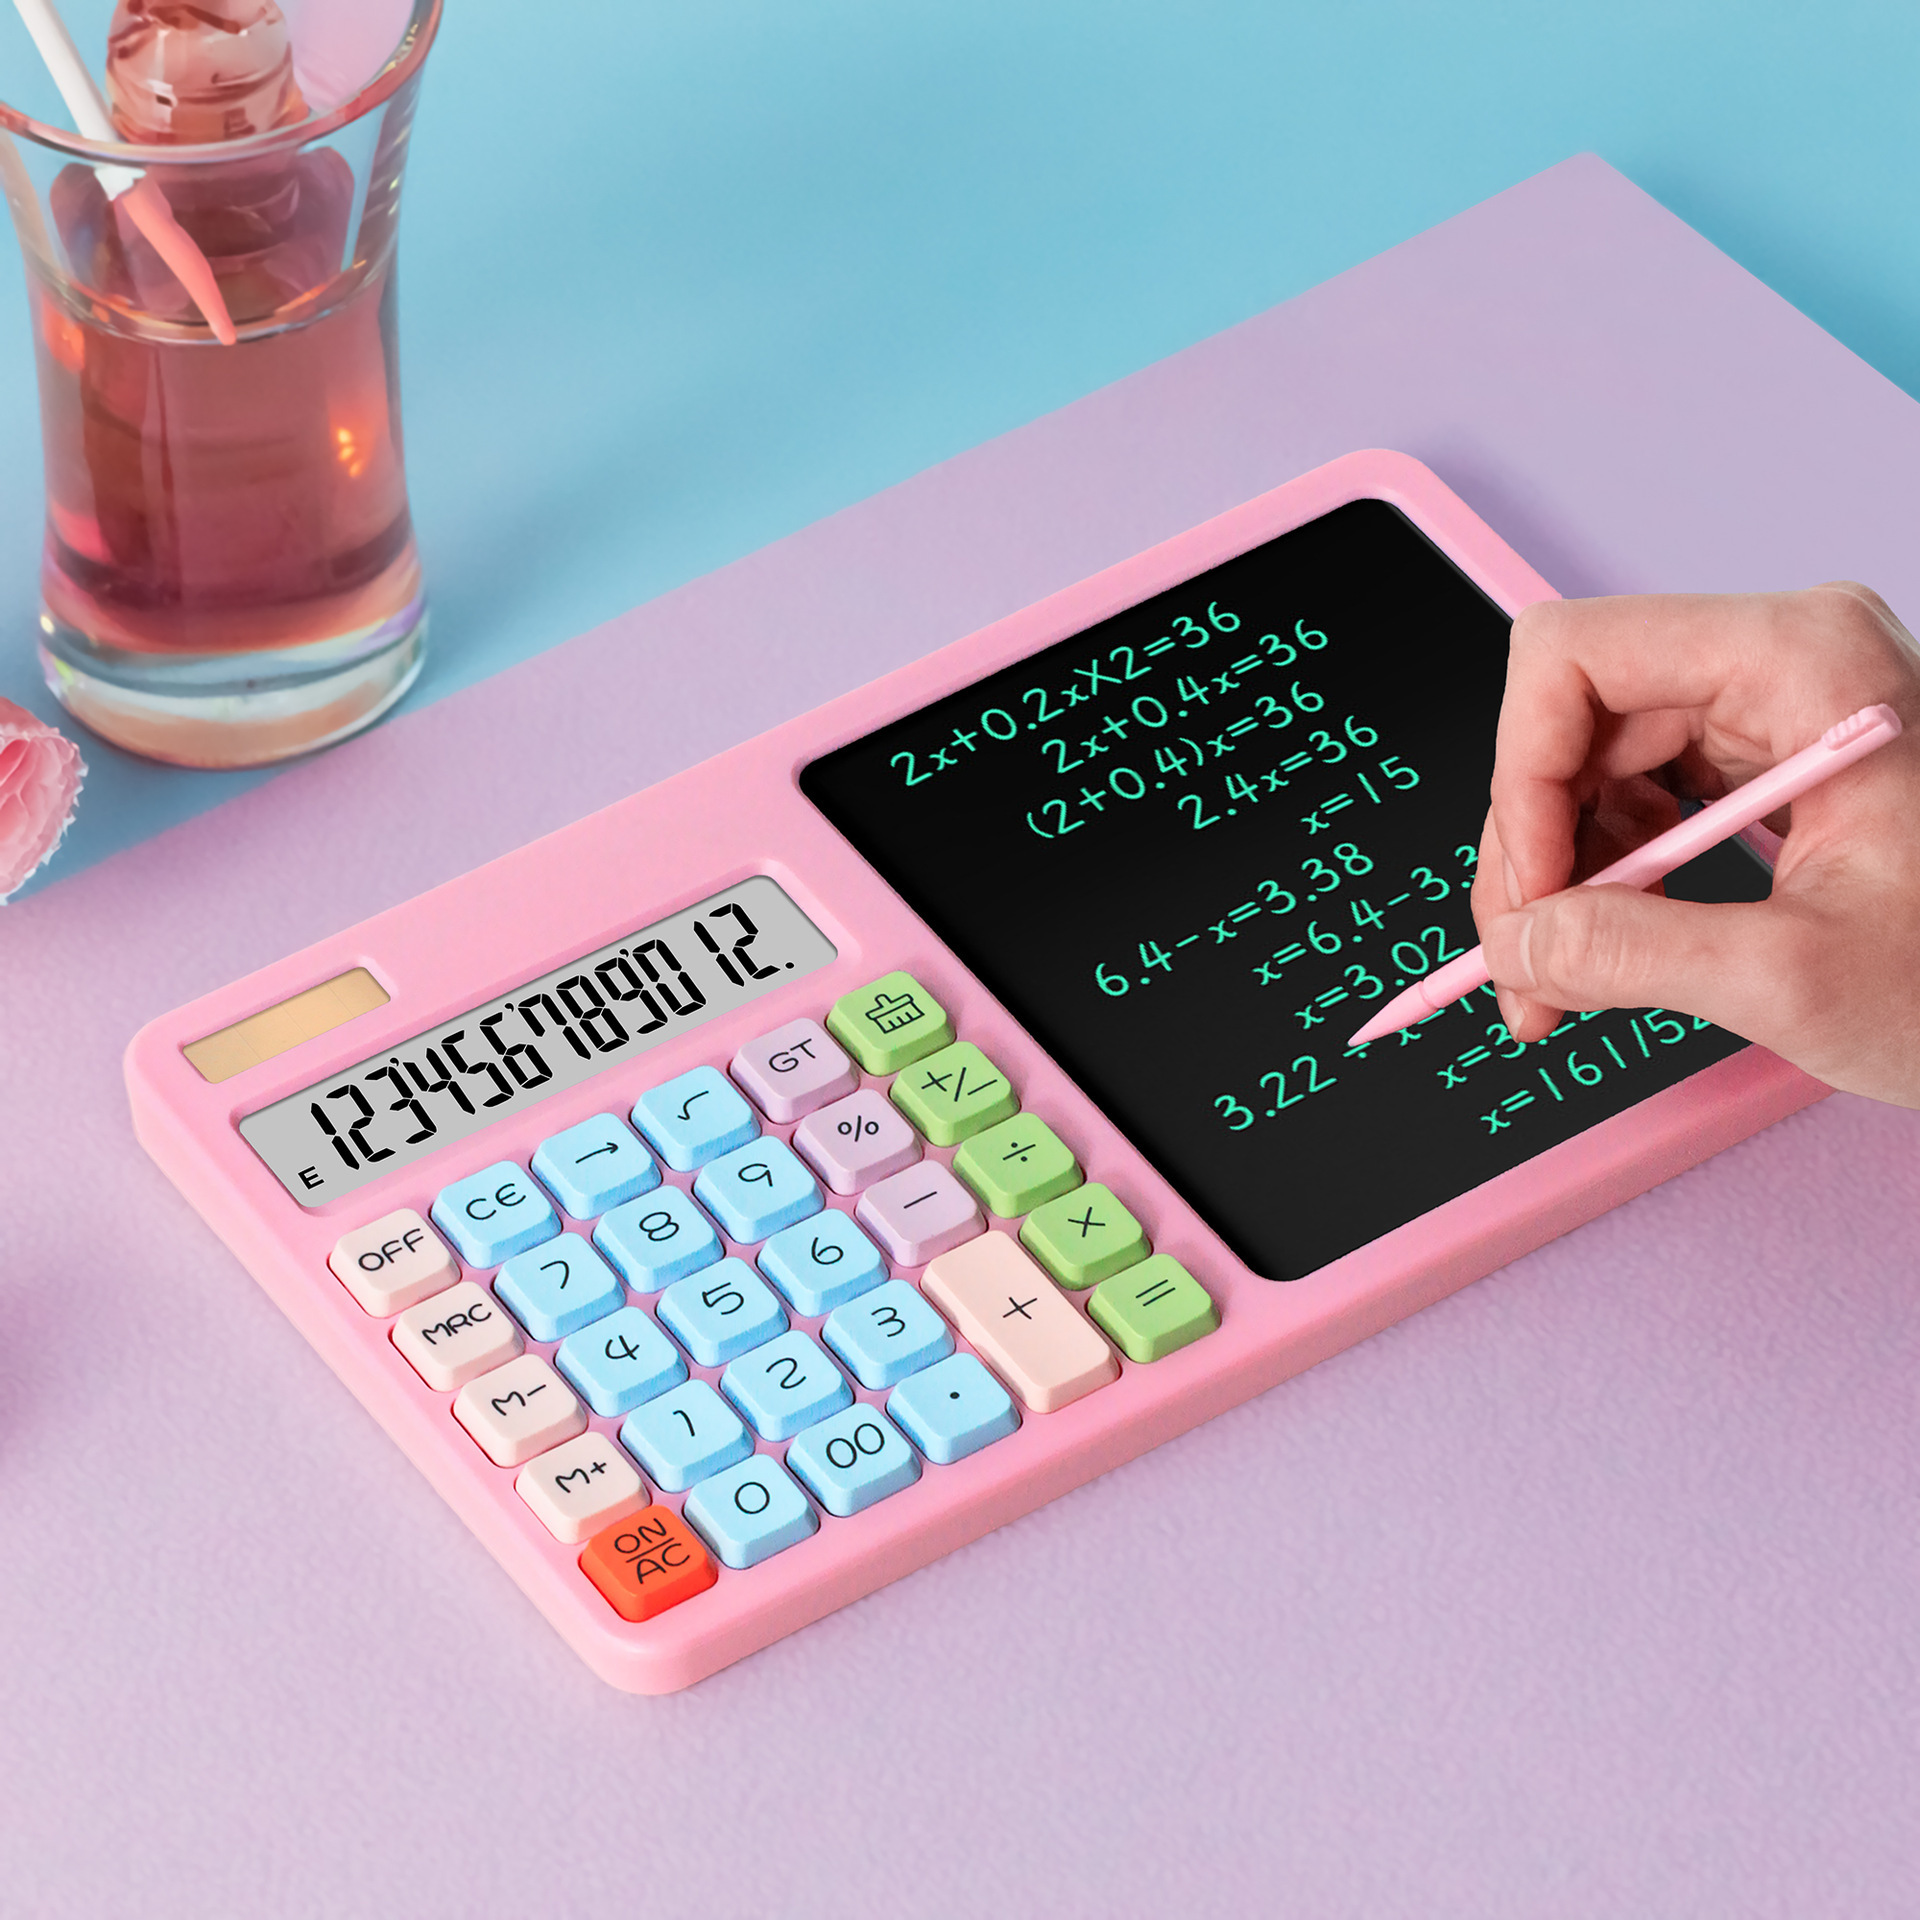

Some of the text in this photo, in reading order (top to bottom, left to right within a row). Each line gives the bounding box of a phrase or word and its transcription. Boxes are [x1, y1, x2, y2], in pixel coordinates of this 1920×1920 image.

[1041, 618, 1329, 774] 2x+0.4x=36
[1026, 680, 1325, 839] (2+0.4)x=36
[1177, 715, 1379, 830] 2.4x=36
[1301, 755, 1420, 835] x=15
[1095, 842, 1374, 997] 6.4-x=3.38
[1294, 926, 1466, 1030] x=3.02
[768, 1038, 816, 1073] GT
[837, 1115, 879, 1142] %
[297, 1165, 325, 1190] E
[738, 1160, 773, 1187] 9
[466, 1183, 526, 1220] CE
[639, 1211, 680, 1242] 8
[358, 1228, 424, 1272] OFF
[811, 1237, 844, 1265] 6
[702, 1282, 744, 1315] 5
[421, 1303, 492, 1345] MRC
[871, 1307, 906, 1338] 3
[605, 1335, 640, 1363] 4
[766, 1357, 806, 1389] 2
[673, 1410, 695, 1437] 1
[826, 1423, 885, 1469] 00
[555, 1460, 607, 1493] M+
[734, 1481, 770, 1515] 0
[614, 1518, 667, 1554] ON
[637, 1543, 690, 1584] AC
